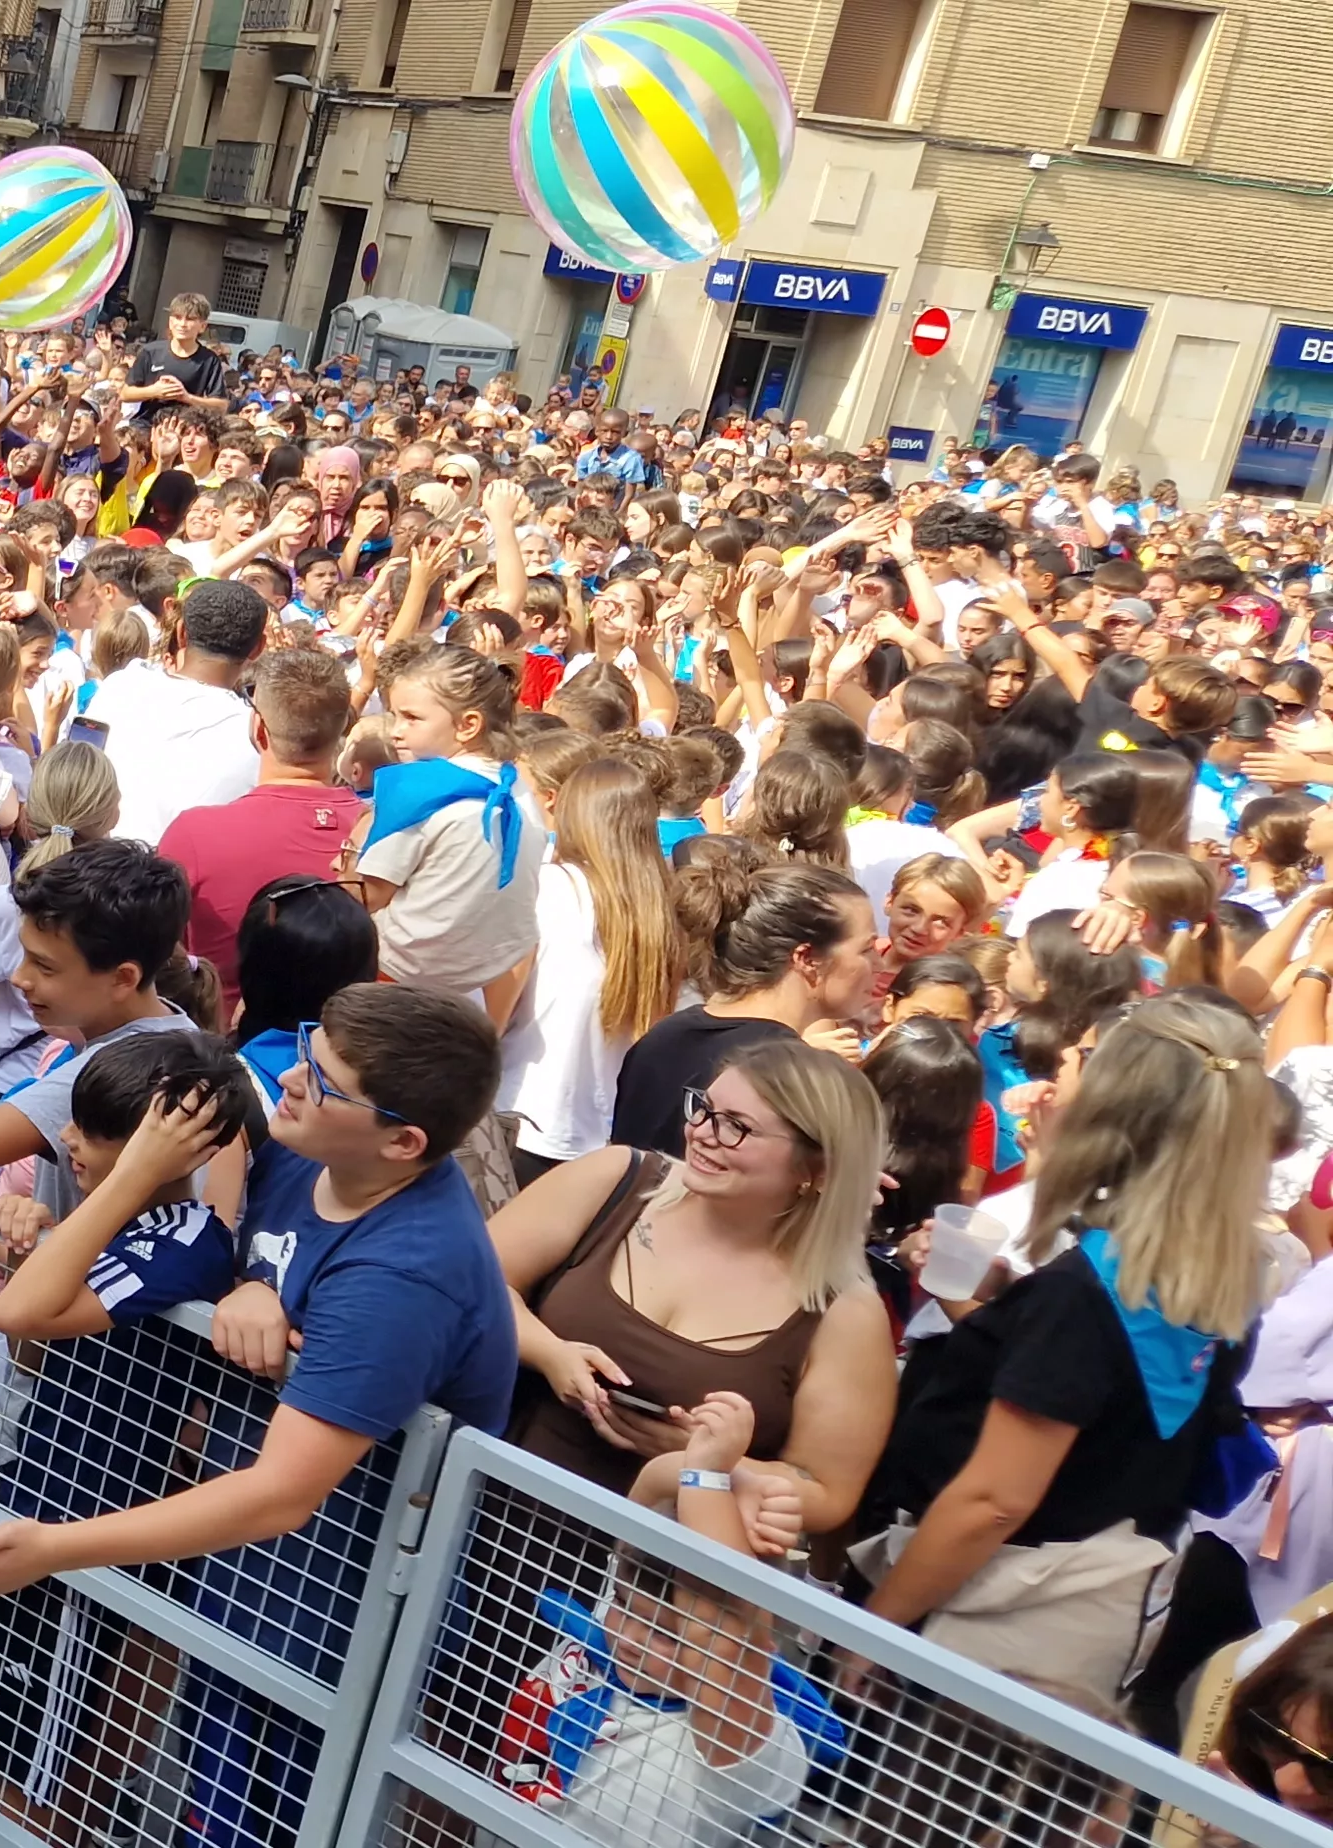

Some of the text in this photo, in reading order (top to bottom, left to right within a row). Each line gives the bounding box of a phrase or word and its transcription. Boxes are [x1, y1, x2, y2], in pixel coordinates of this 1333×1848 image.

[712, 271, 734, 286] BBVA
[773, 273, 850, 301] BBVA
[1036, 306, 1112, 336] BBVA
[1000, 339, 1091, 377] Entra
[890, 437, 924, 450] BBVA
[1206, 1694, 1225, 1716] RUE
